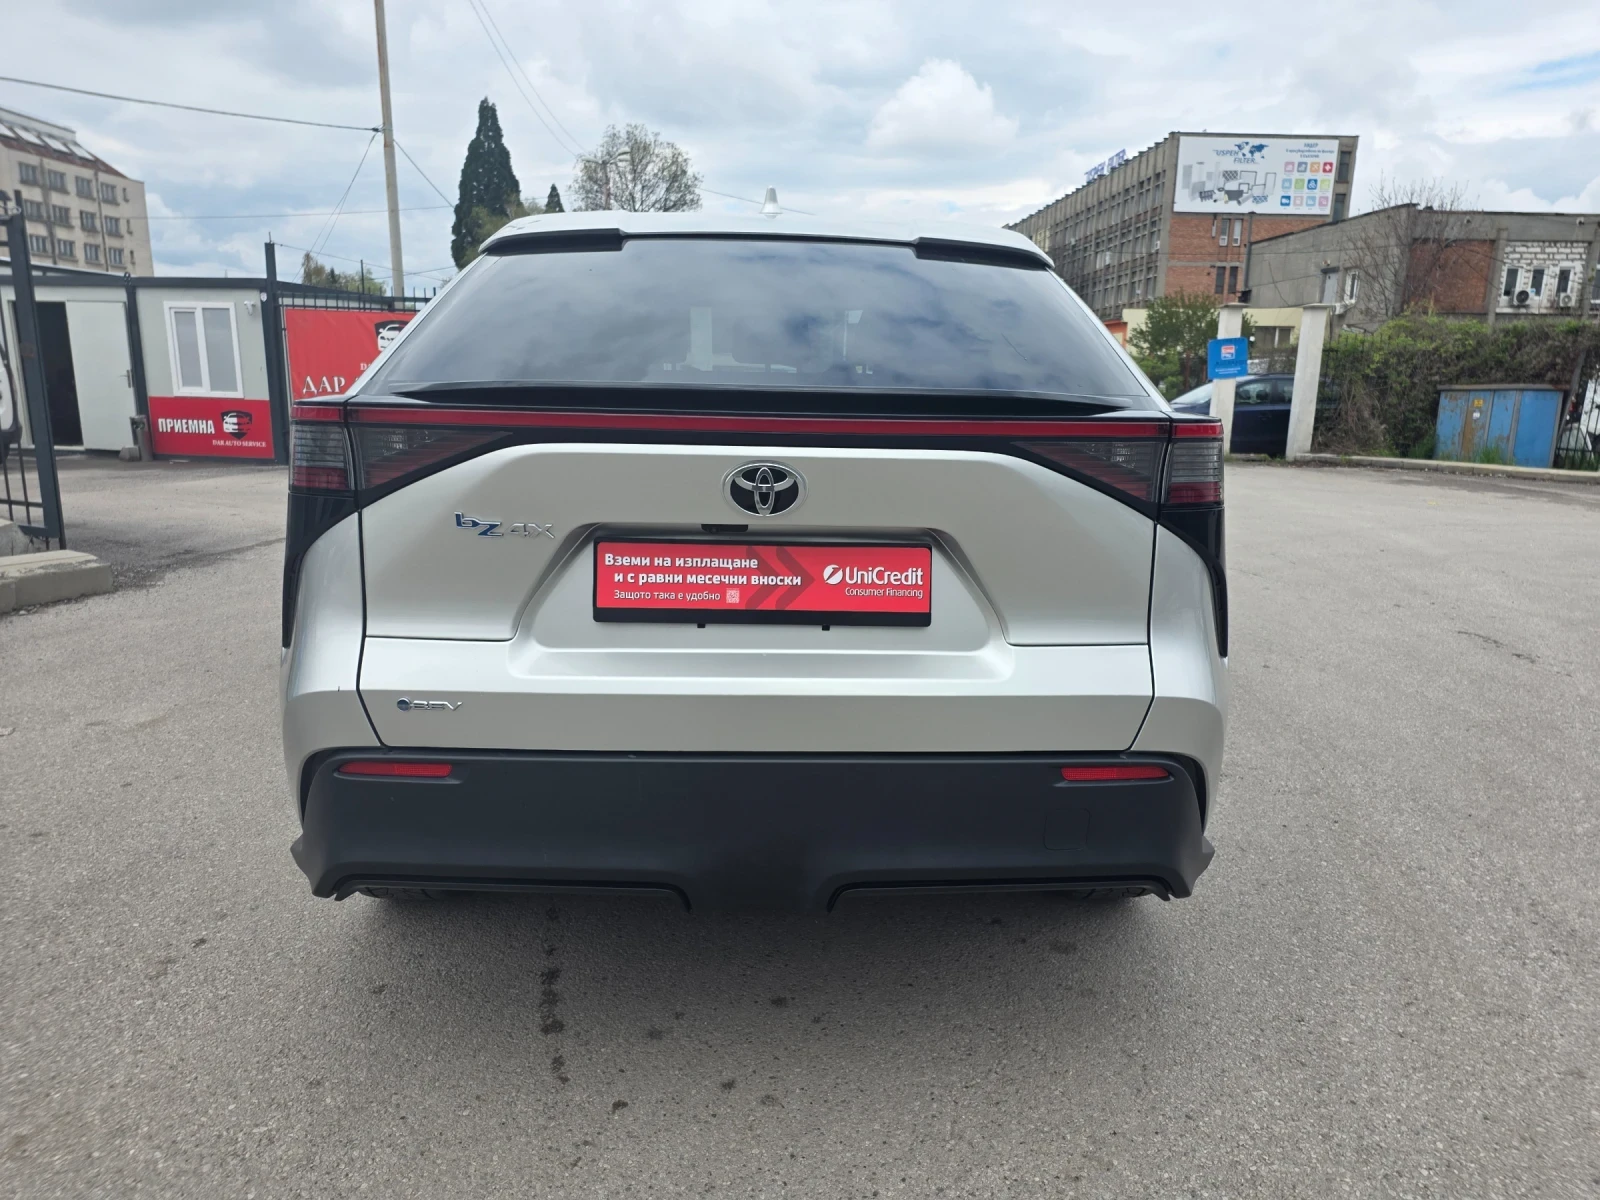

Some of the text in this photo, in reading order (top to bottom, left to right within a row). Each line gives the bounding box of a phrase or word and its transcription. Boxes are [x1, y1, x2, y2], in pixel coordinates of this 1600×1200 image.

[1215, 149, 1240, 157] USPEH
[303, 375, 346, 394] ДАР
[158, 418, 216, 435] ПРИЕМНА
[604, 553, 759, 570] Вземи на изплащане
[614, 573, 802, 586] и с равни месечни вноски
[845, 566, 924, 586] UniCredit
[614, 590, 721, 602] Защото така е удобно
[845, 587, 923, 600] Consumer Financing
